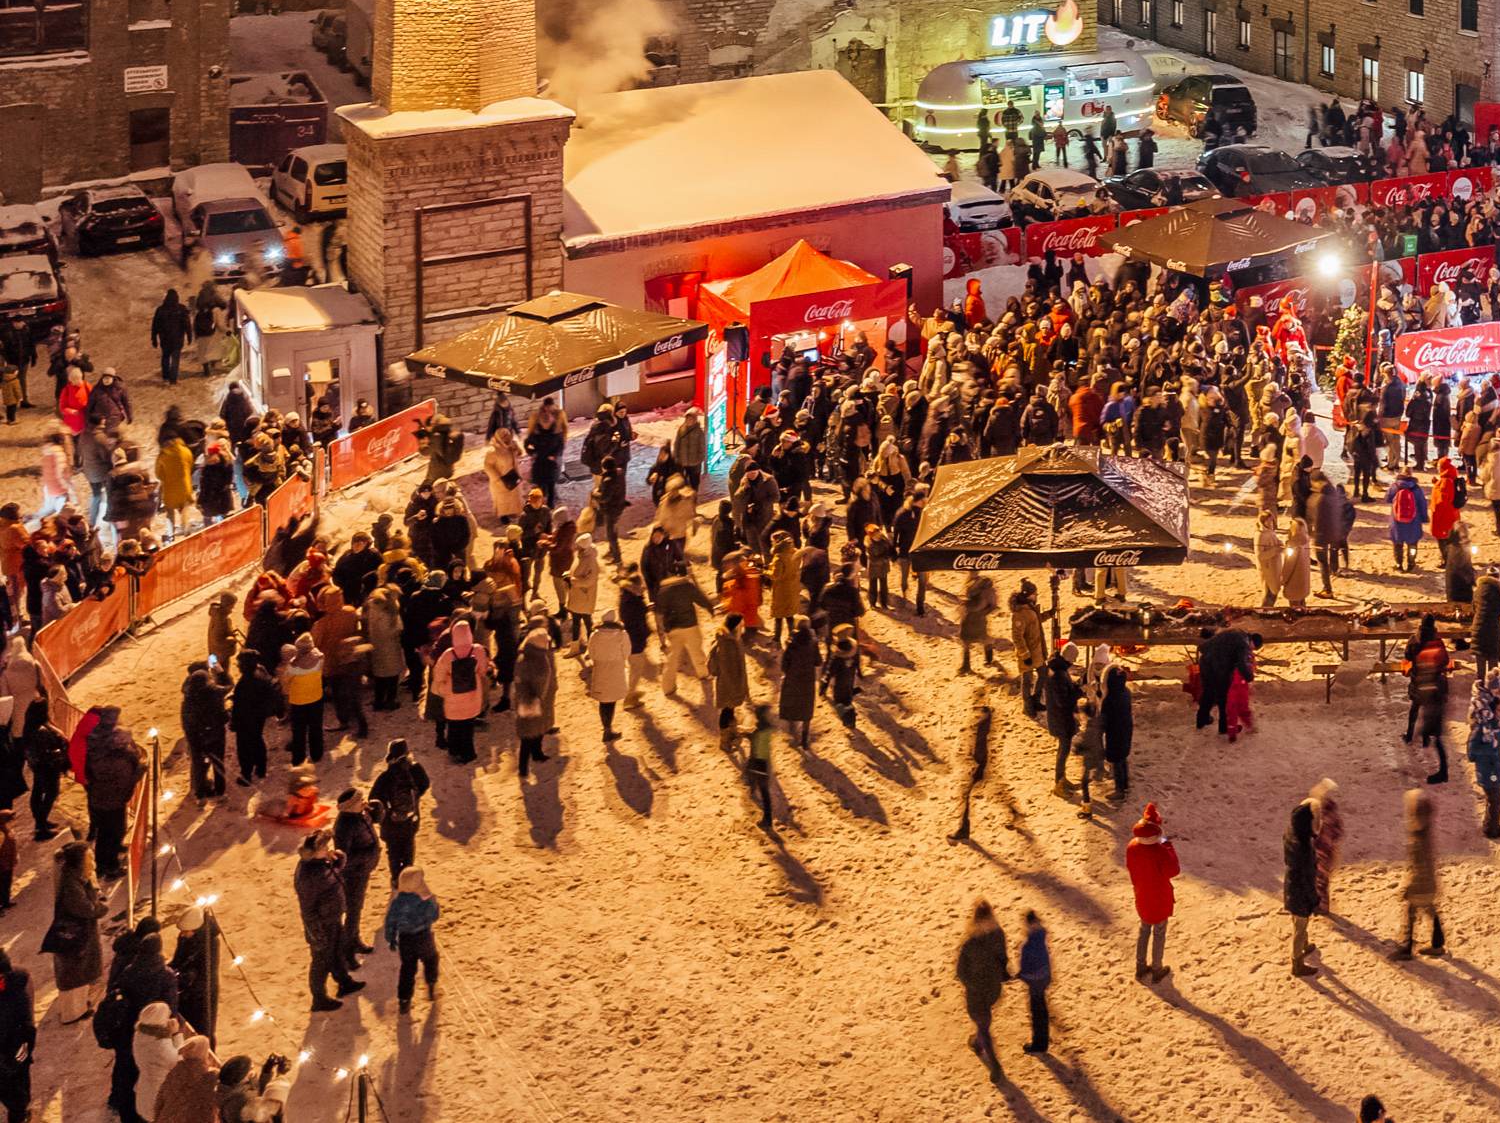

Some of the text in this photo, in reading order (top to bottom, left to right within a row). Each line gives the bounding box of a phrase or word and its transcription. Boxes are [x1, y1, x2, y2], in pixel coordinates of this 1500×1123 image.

[991, 14, 1048, 47] LIT
[297, 125, 314, 137] 34
[1042, 227, 1099, 253] Coca-Cola
[804, 300, 855, 323] Coca-Cola
[653, 334, 683, 355] Coca-Cola
[1414, 335, 1485, 370] Coca-Cola
[564, 365, 595, 387] Coca-Cola
[953, 553, 1002, 570] Coca-Cola
[1093, 550, 1143, 566] Coca-Cola
